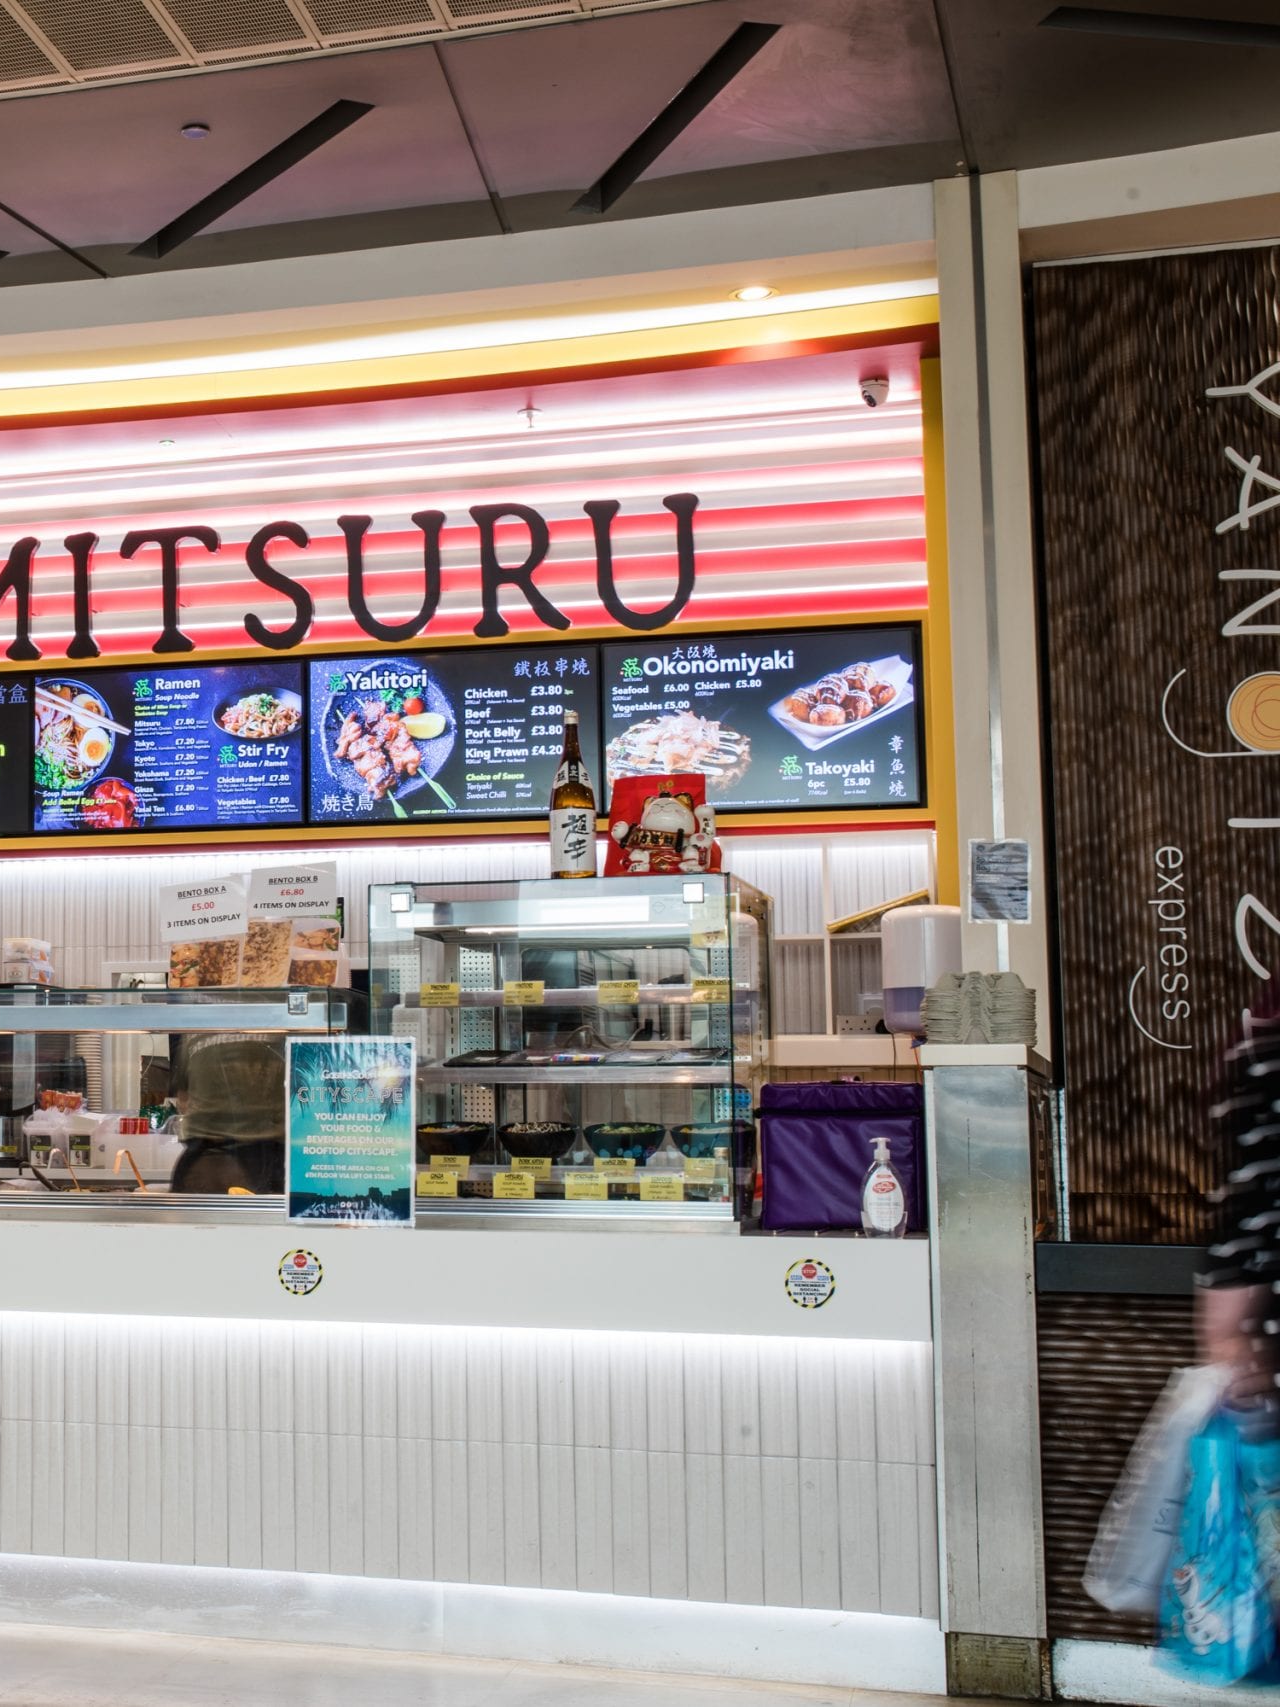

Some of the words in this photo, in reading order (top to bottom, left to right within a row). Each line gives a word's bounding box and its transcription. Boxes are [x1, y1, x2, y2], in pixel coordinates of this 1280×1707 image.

[643, 650, 794, 679] Okonomiyaki
[154, 678, 201, 691] Ramen
[345, 669, 428, 692] Yakitori
[694, 681, 731, 692] Chicken
[735, 679, 762, 689] £5.80
[464, 688, 508, 699] Chicken
[530, 685, 562, 697] £3.80
[612, 684, 649, 696] Seafood
[663, 682, 690, 693] £6.00
[154, 694, 173, 702] Soup
[174, 692, 200, 700] Noodle
[464, 707, 491, 719] Beef
[530, 704, 563, 716] £3.80
[612, 702, 663, 714] Vegetables
[663, 700, 690, 710] £5.00
[134, 720, 161, 728] Mitsuru
[175, 718, 195, 726] £7.80
[464, 727, 491, 739] Pork
[493, 726, 521, 739] Belly
[530, 724, 563, 736] £3.80
[134, 740, 155, 749] Tokyo
[237, 744, 263, 757] Stir
[266, 743, 290, 759] Fry
[465, 748, 491, 761] King
[493, 747, 529, 757] Prawn
[531, 745, 564, 756] £4.20
[134, 755, 156, 764] Kyoto
[175, 753, 195, 761] £7.20
[134, 770, 170, 778] Yokohama
[175, 768, 195, 776] £7.20
[805, 759, 875, 778] Takoyaki
[216, 776, 245, 784] Chicken
[248, 775, 266, 783] Beef
[269, 774, 290, 782] £7.80
[465, 773, 491, 782] Choice
[492, 772, 502, 781] of
[502, 772, 525, 780] Sauce
[175, 784, 195, 792] £7.20
[466, 783, 493, 792] Teriyaki
[807, 780, 826, 789] 6pc
[843, 777, 871, 787] £5.80
[42, 790, 60, 798] Soup
[466, 792, 488, 800] Sweet
[488, 791, 507, 799] Chilli
[81, 797, 95, 806] Egg
[216, 798, 257, 807] Vegetables
[322, 794, 374, 813] 焼き鳥
[175, 804, 195, 812] £6.80
[269, 877, 293, 885] BENTO
[177, 889, 202, 899] BENTO
[203, 887, 219, 895] BOX
[220, 885, 227, 893] A
[280, 888, 304, 896] £6.80
[191, 901, 215, 912] £5.00
[259, 902, 283, 910] ITEMS
[284, 901, 297, 909] ON
[167, 921, 172, 929] 3
[173, 918, 196, 928] ITEMS
[197, 916, 210, 925] ON
[211, 913, 241, 923] DISPLAY
[1148, 845, 1191, 1020] express
[297, 1086, 404, 1104] CITYSCAPE
[314, 1112, 334, 1122] YOU
[335, 1112, 356, 1122] CAN
[356, 1112, 387, 1122] ENJOY
[320, 1124, 345, 1133] YOUR
[346, 1124, 373, 1133] FOOD
[374, 1125, 381, 1133] &
[306, 1135, 358, 1144] BEVERAGES
[358, 1136, 376, 1145] ON
[376, 1136, 395, 1145] OUR
[302, 1146, 346, 1156] ROOFTOP
[346, 1147, 398, 1156] CITYSCAPE.
